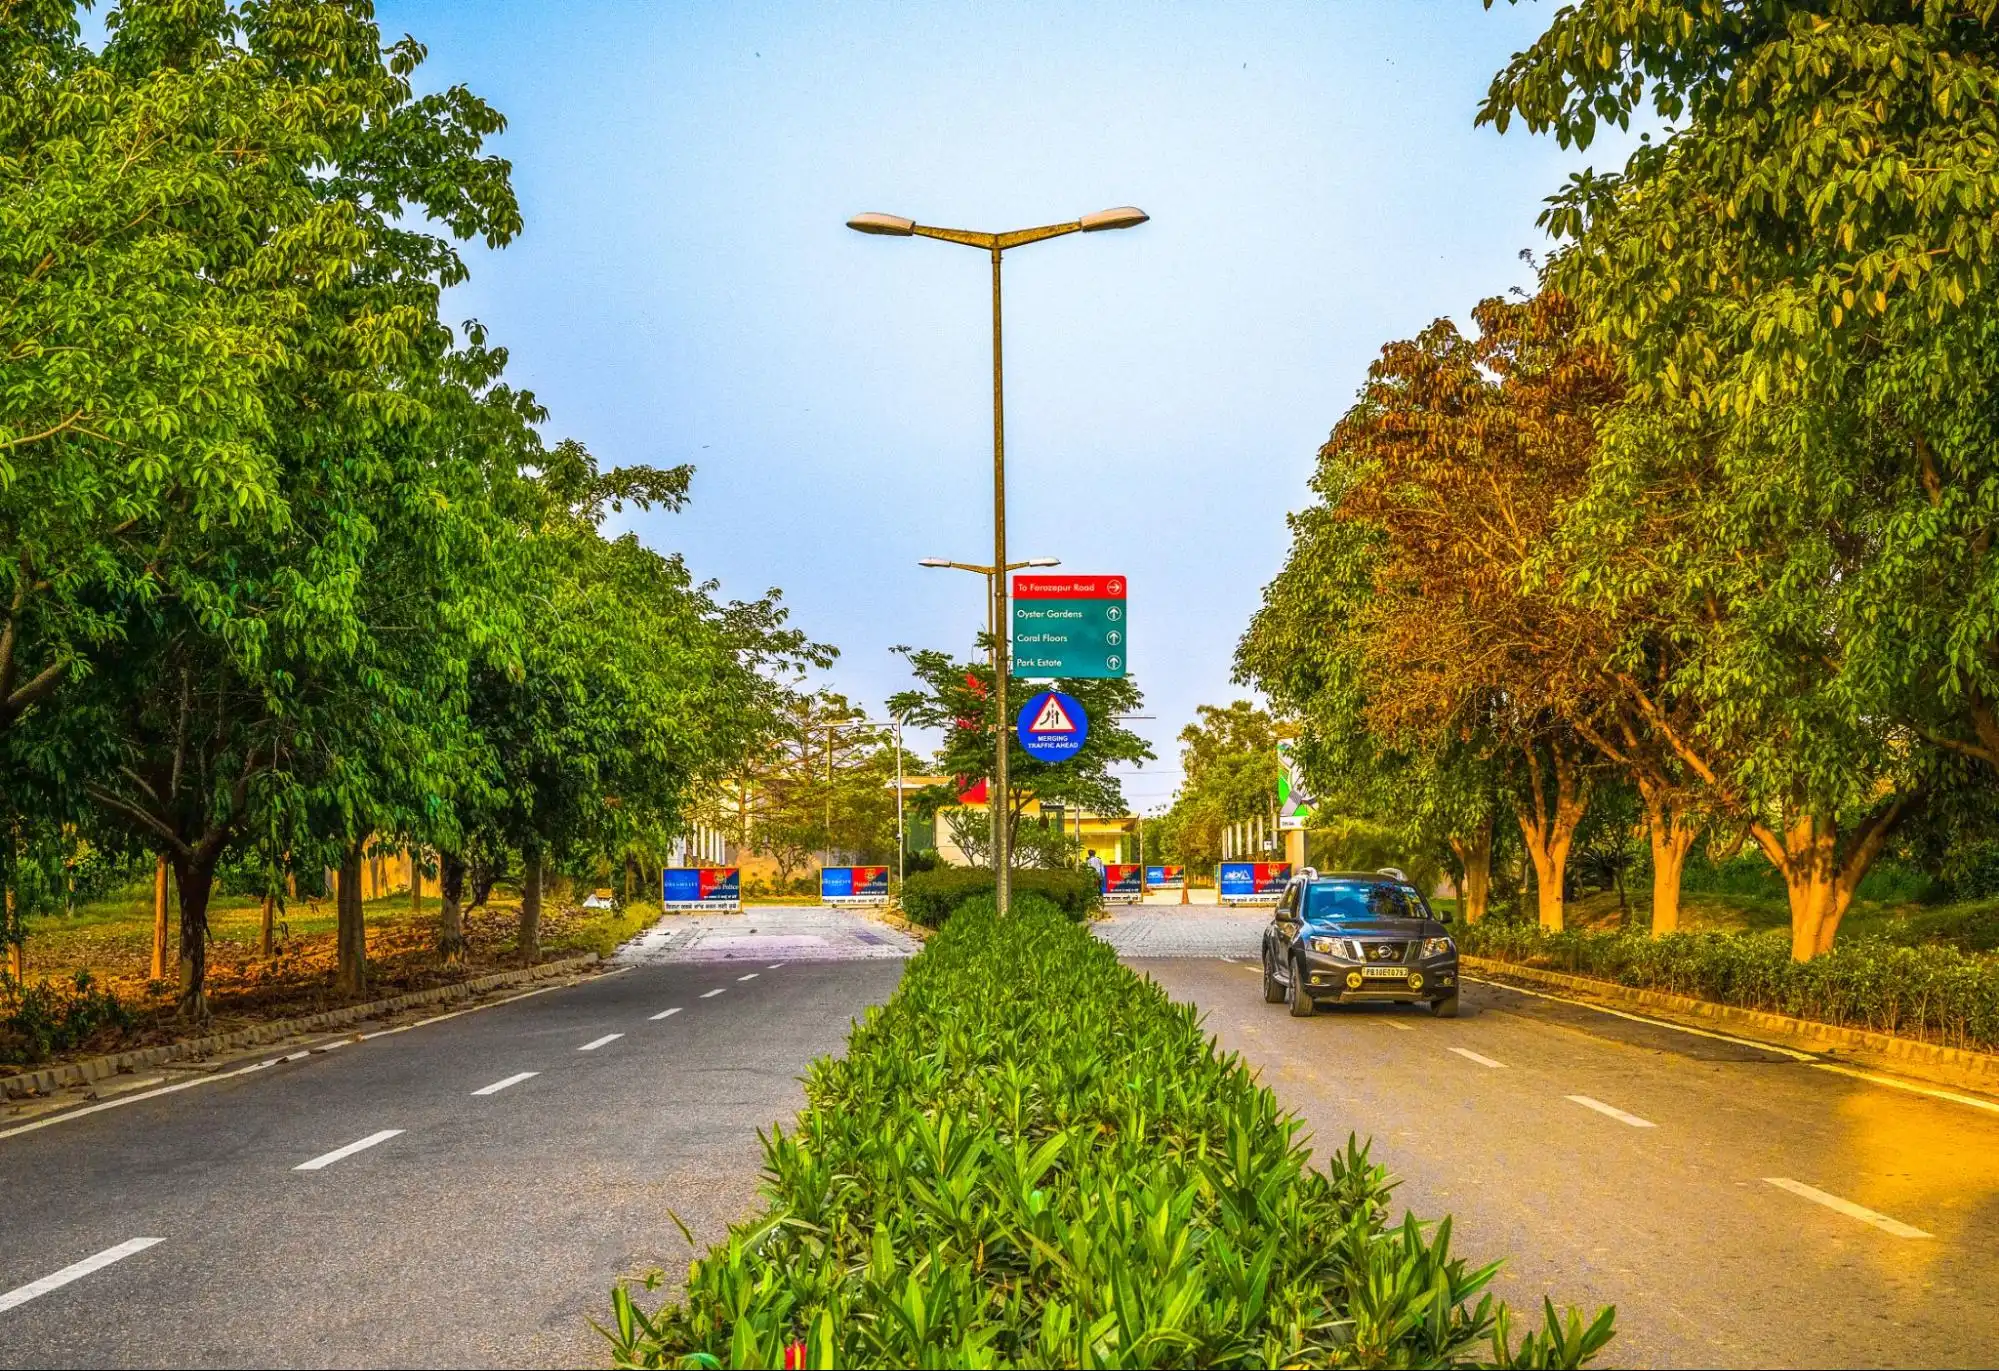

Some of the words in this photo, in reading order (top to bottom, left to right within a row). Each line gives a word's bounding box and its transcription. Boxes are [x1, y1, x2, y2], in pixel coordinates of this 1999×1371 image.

[1018, 583, 1027, 592] To
[1073, 583, 1095, 592] Road
[1017, 609, 1045, 620] Oyster
[1047, 609, 1083, 618] Gardens
[1017, 634, 1040, 642] Coral
[1042, 634, 1068, 642] Floors
[1017, 658, 1035, 667] Park
[1037, 658, 1062, 667] Estate
